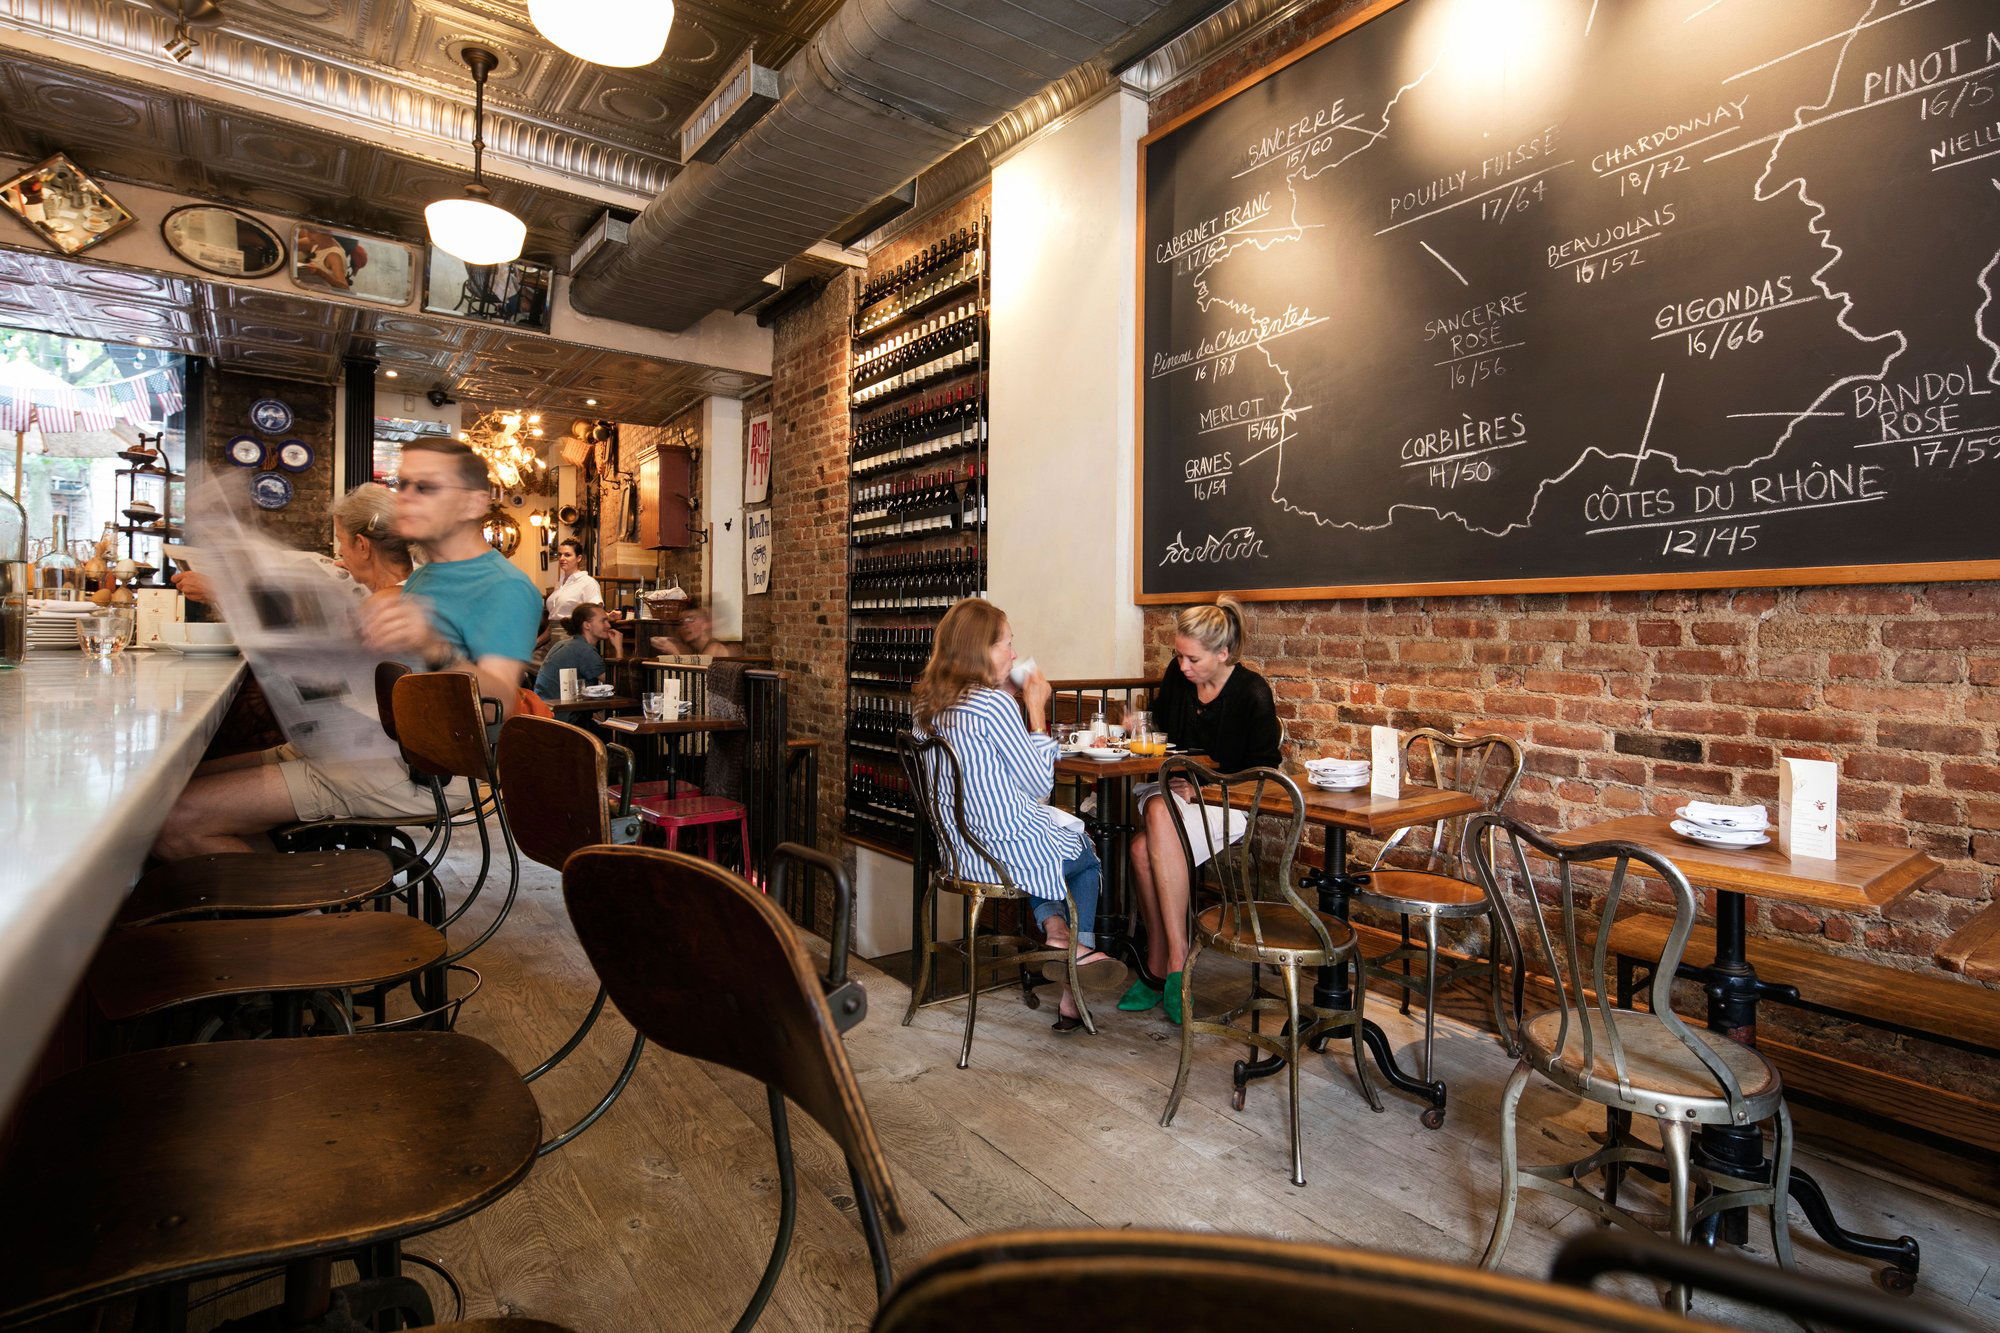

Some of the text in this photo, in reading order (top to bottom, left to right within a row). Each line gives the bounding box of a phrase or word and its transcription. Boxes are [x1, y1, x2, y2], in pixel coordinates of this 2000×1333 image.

[1864, 38, 1971, 103] PINOT
[1249, 98, 1344, 166] SANCERRE
[1286, 137, 1332, 169] 15/60
[1592, 94, 1749, 172] CHARDONNAY
[1930, 121, 2000, 164] NIELL
[1620, 155, 1690, 197] 18/72
[1482, 180, 1548, 224] 17/64
[1156, 191, 1272, 263] CABERNET FRANC
[1548, 203, 1676, 267] BEAUJOLAIS
[1187, 236, 1227, 271] 17/62
[1576, 249, 1646, 283] 16/52
[1424, 292, 1527, 341] SANCERRE
[1655, 276, 1793, 330] GIGONDAS
[1152, 352, 1193, 375] Pineau
[1196, 337, 1215, 359] des
[1451, 320, 1502, 356] ROSÉ
[1688, 316, 1764, 360] 16/66
[1451, 357, 1506, 389] 16/56
[1852, 364, 1991, 418] BANDOL
[1200, 398, 1263, 429] MERLOT
[1247, 420, 1278, 442] 15/46
[1880, 397, 1959, 441] ROSÉ
[1401, 412, 1526, 460] CORBIÈRES
[1185, 451, 1232, 479] GRAVES
[1429, 461, 1491, 489] 14/50
[1194, 479, 1226, 500] 16/54
[1585, 461, 1888, 522] CÔTES DU RHÔNE
[1662, 525, 1760, 557] 12/45
